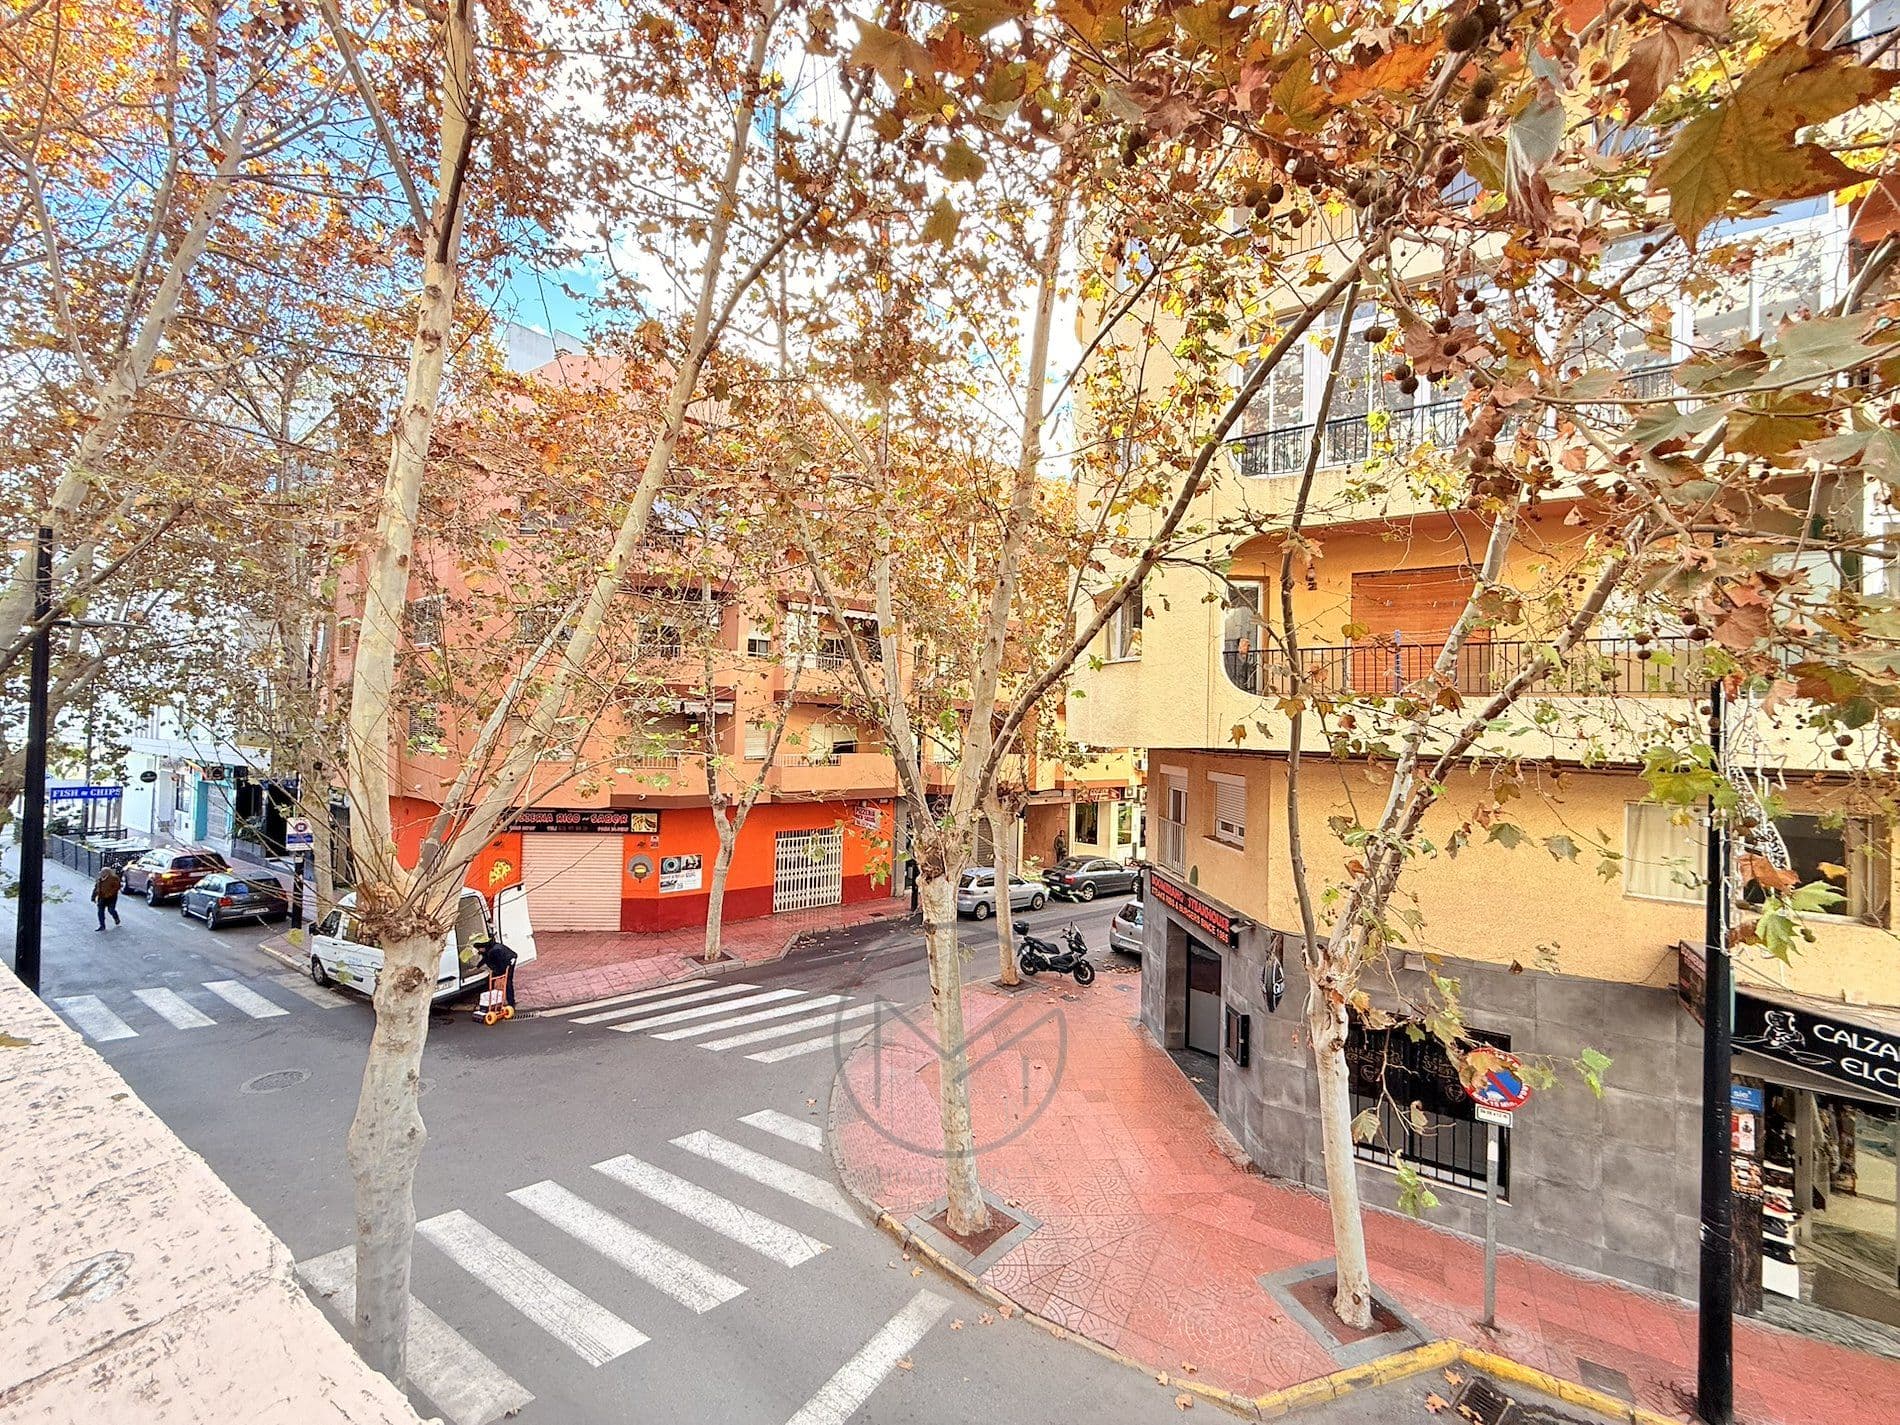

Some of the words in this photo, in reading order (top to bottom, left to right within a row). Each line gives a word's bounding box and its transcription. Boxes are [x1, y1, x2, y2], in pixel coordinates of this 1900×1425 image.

[52, 789, 79, 797] FISH
[90, 788, 121, 796] CHIPS
[590, 813, 628, 823] SABOR
[1201, 917, 1216, 935] SINCE
[1812, 1024, 1900, 1062] CALZA
[1840, 1057, 1900, 1089] ELC
